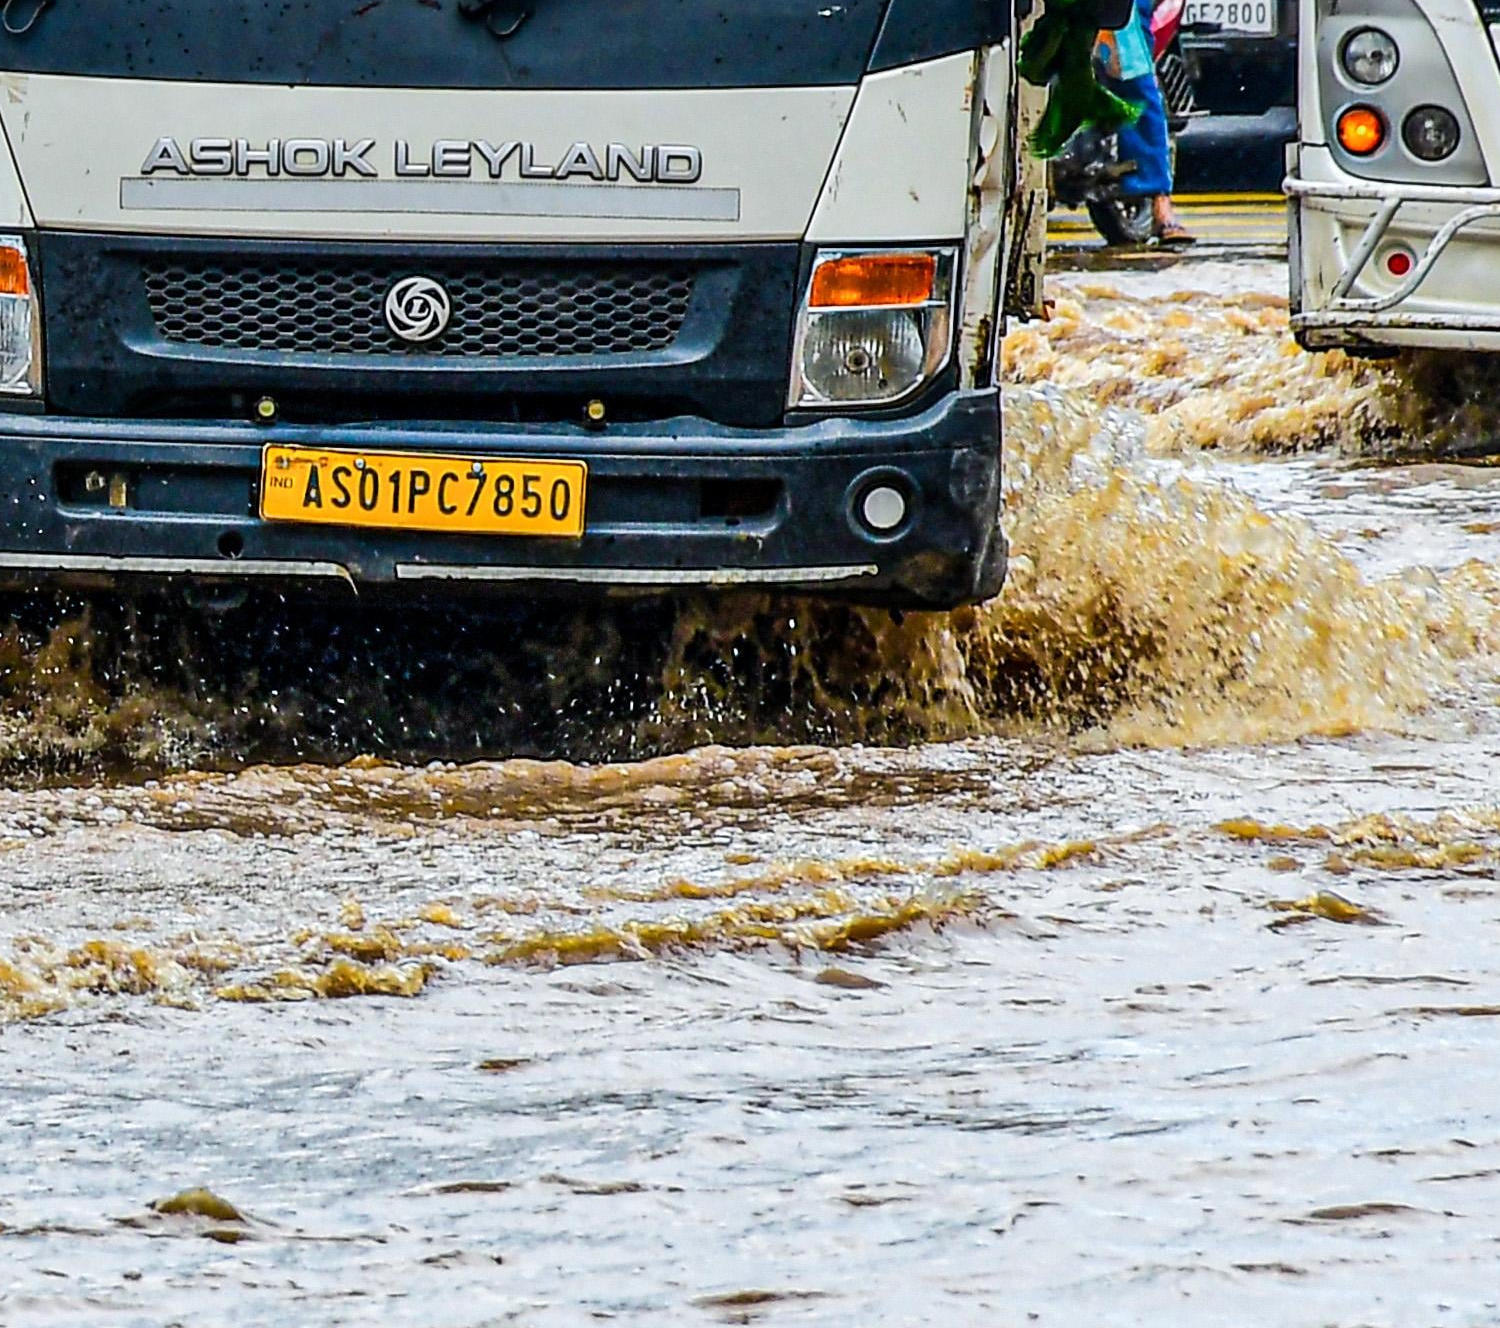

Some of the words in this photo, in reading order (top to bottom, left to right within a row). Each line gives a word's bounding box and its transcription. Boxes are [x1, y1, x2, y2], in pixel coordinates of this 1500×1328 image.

[141, 136, 378, 177] ASHOK
[396, 139, 703, 183] LEYLAND
[269, 475, 294, 489] IND
[302, 464, 571, 521] AS01PC7850
